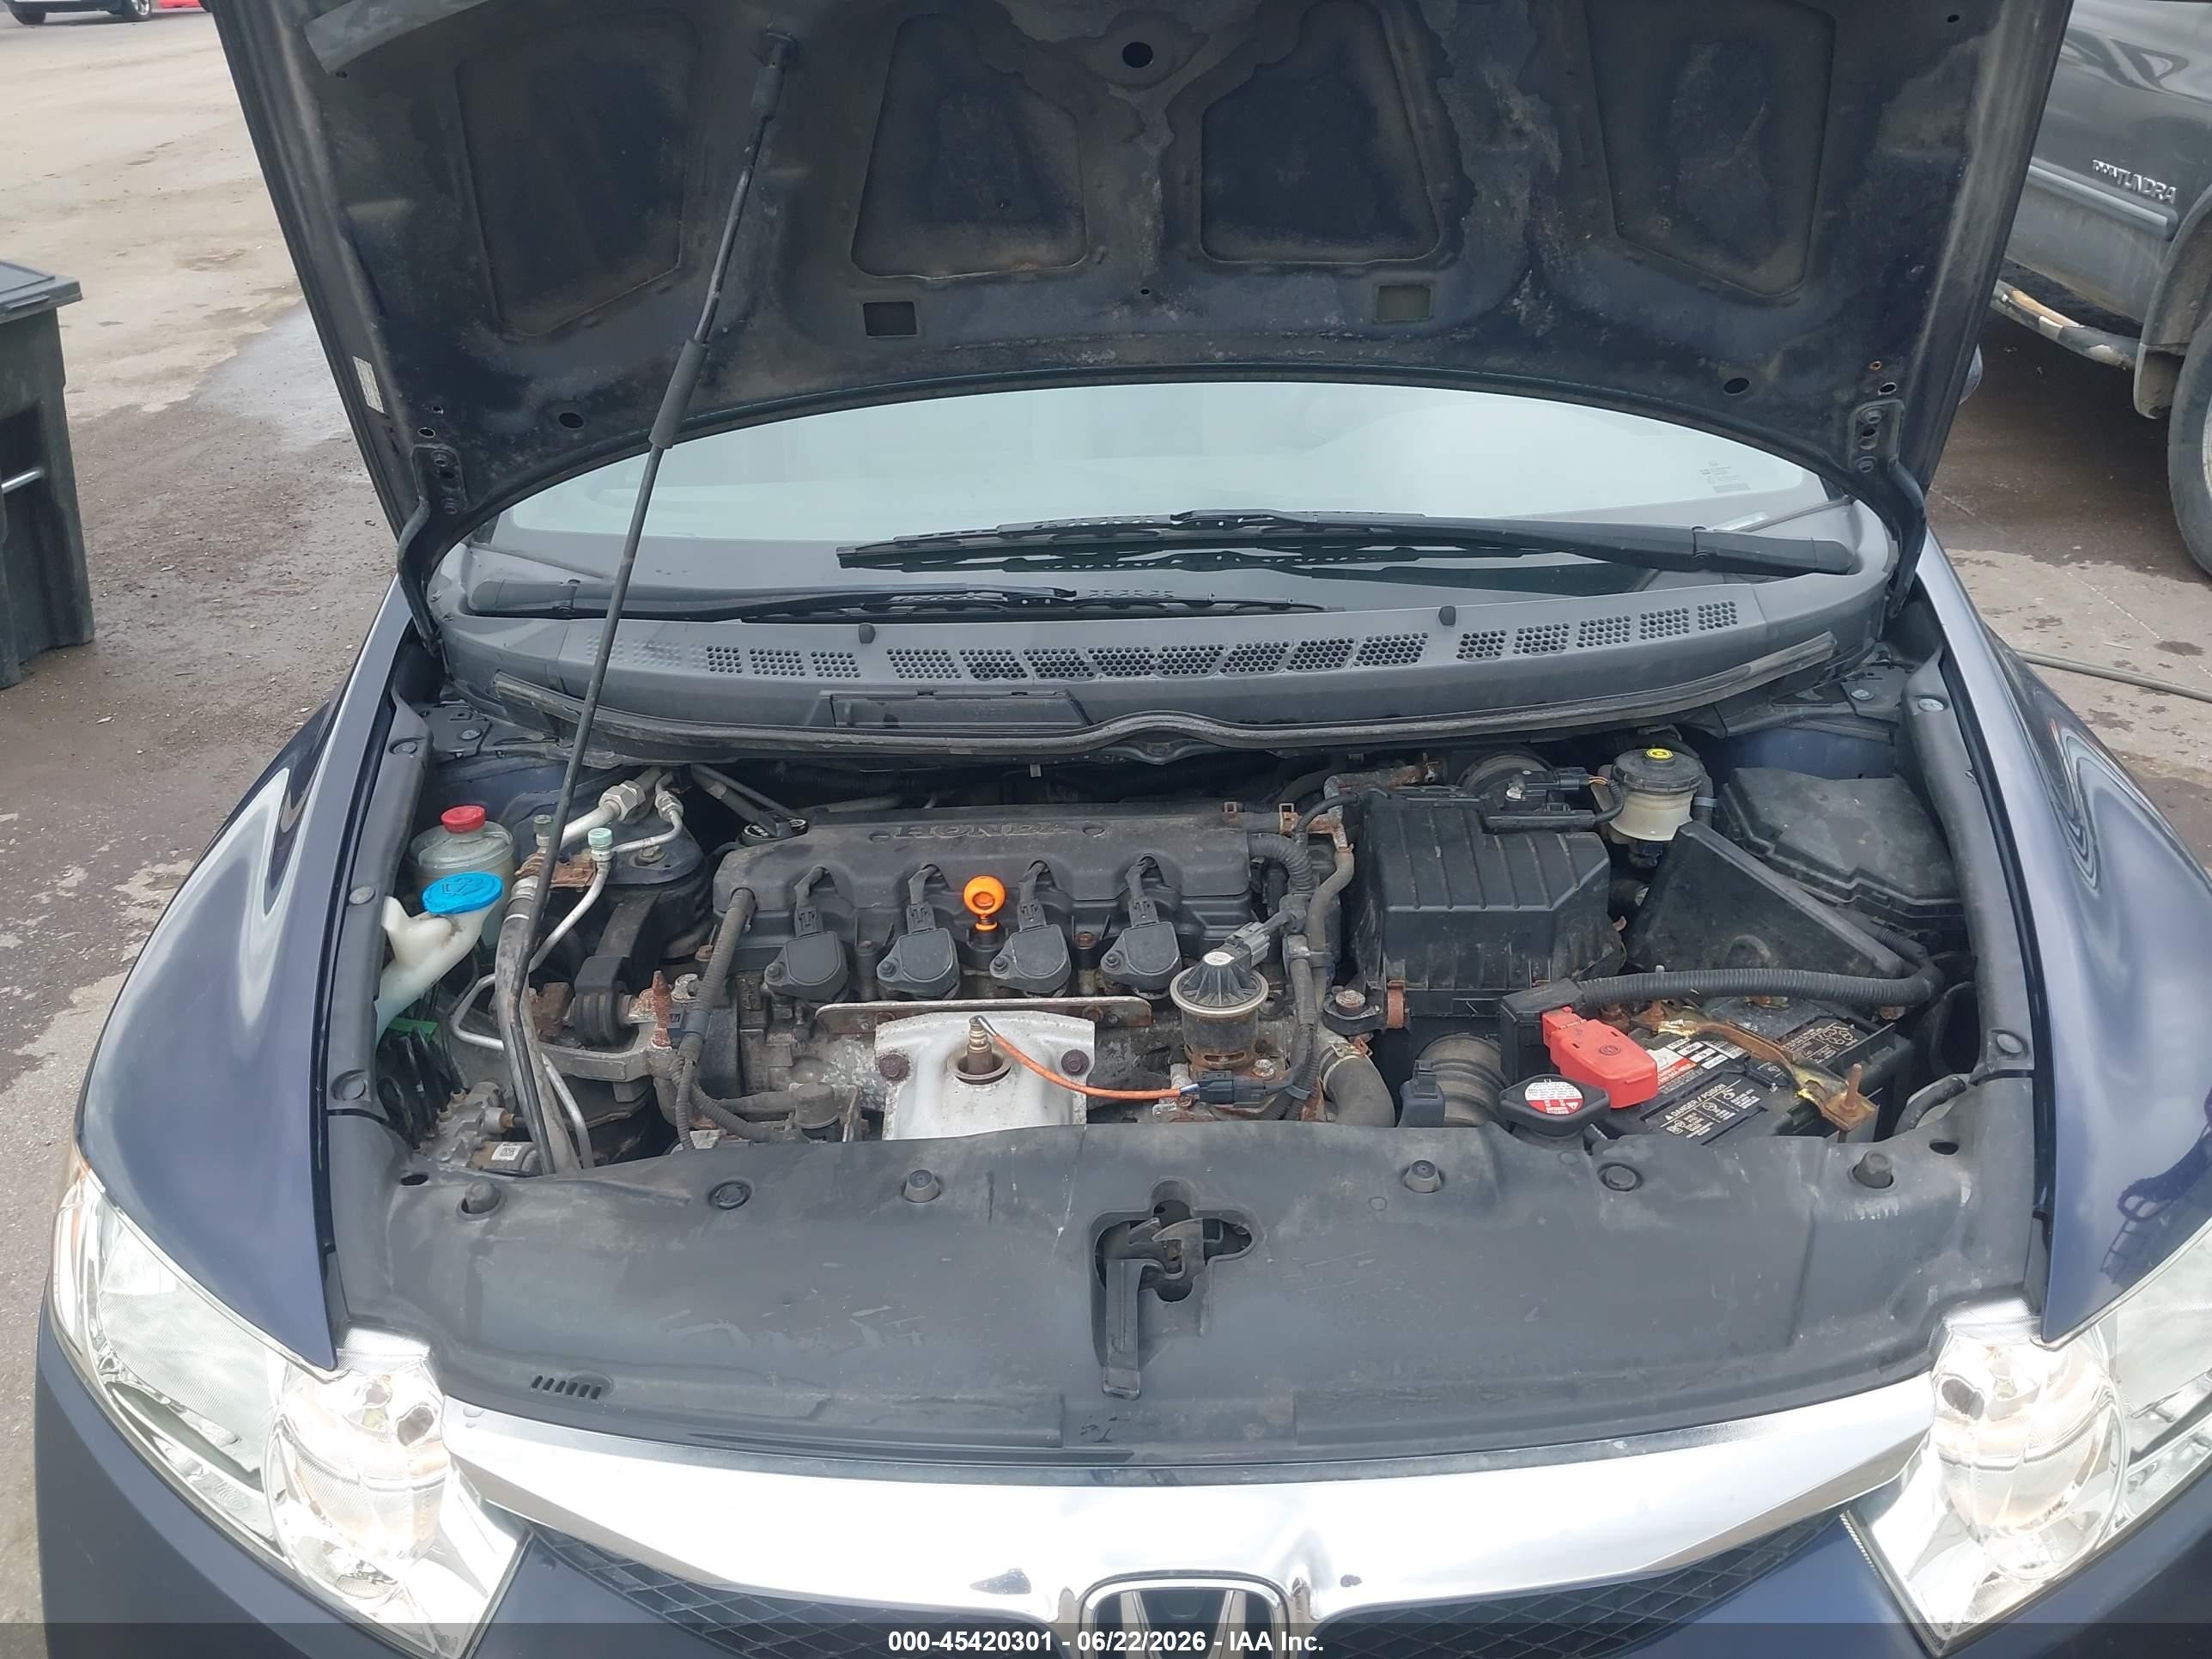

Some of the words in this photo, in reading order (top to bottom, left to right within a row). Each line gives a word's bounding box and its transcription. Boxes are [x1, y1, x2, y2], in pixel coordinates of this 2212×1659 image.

[2116, 167, 2177, 204] TUNDRA
[1671, 1099, 1699, 1117] DANGER
[1701, 1083, 1727, 1100] POISON
